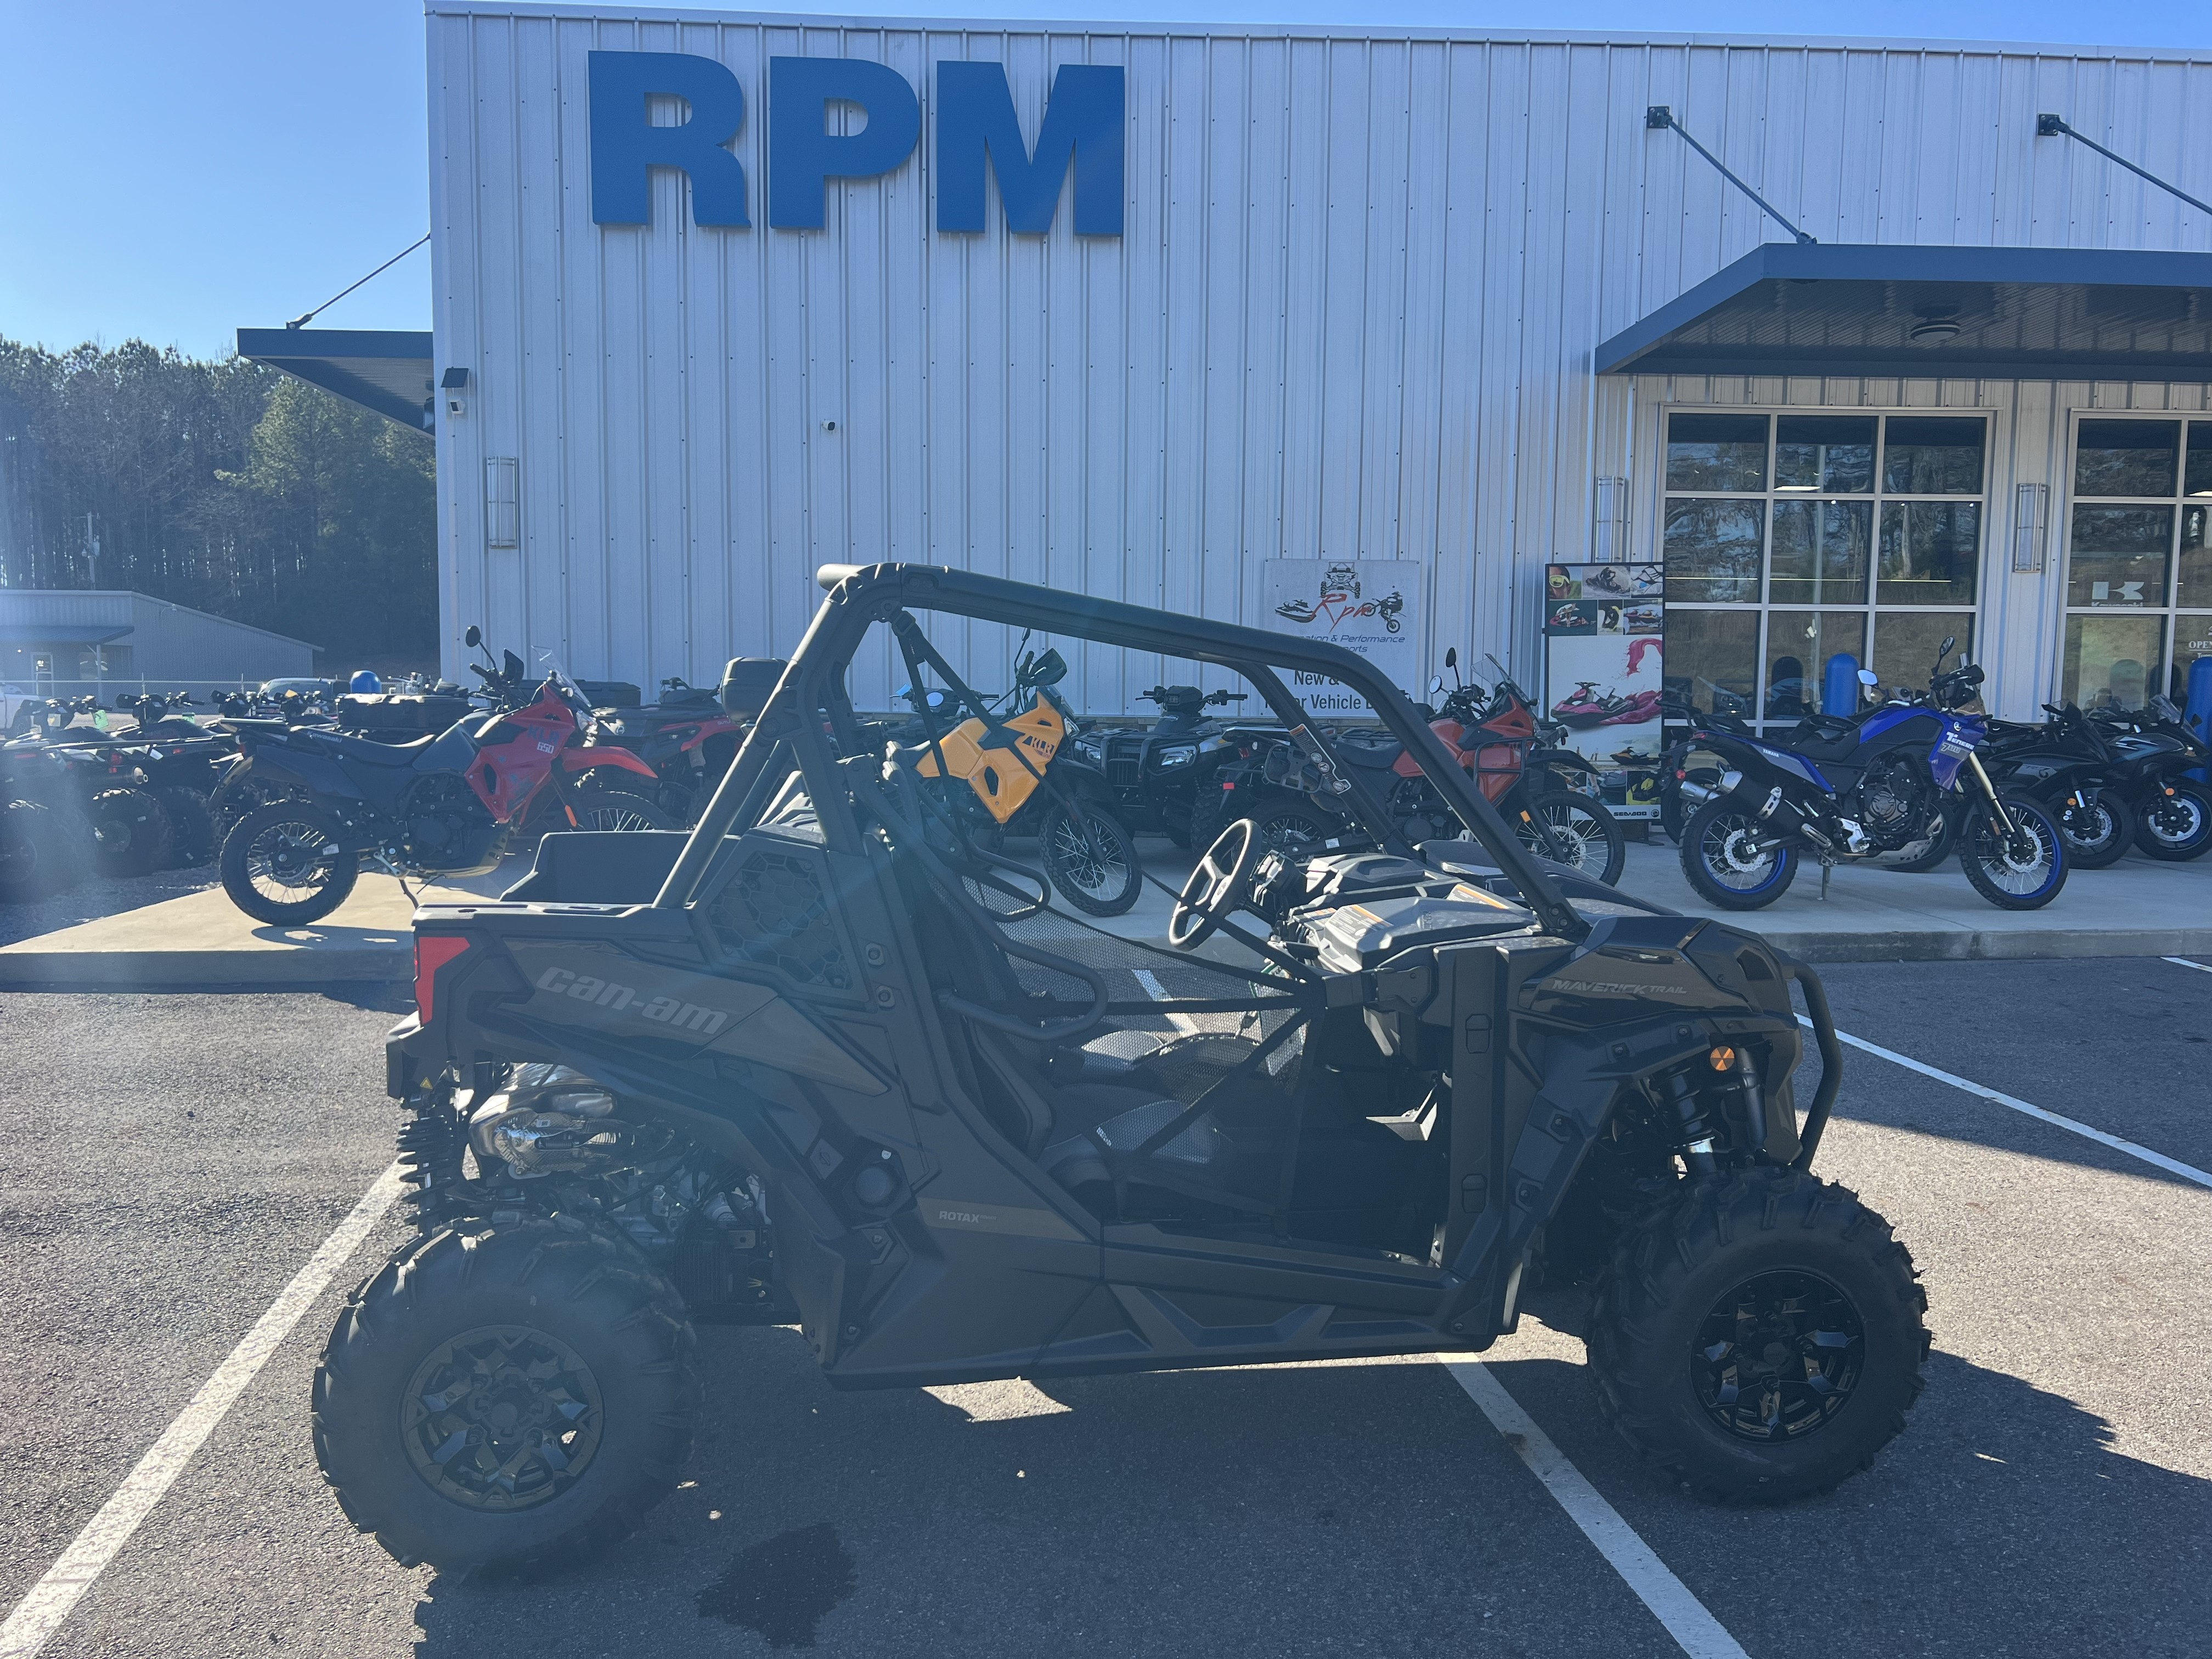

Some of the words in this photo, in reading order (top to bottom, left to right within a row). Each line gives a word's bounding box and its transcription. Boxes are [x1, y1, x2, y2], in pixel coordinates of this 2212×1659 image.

[588, 50, 1125, 236] RPM
[1340, 634, 1406, 643] Performance
[1294, 670, 1325, 685] New
[1311, 694, 1361, 709] Vehicle
[537, 742, 555, 754] 650
[1763, 748, 1779, 758] YAMAHA
[1940, 742, 1962, 754] 700
[1552, 979, 1649, 995] MAVERICK
[1649, 985, 1687, 994] TRAIL
[535, 966, 727, 1035] can-am
[939, 1210, 980, 1223] ROTAX
